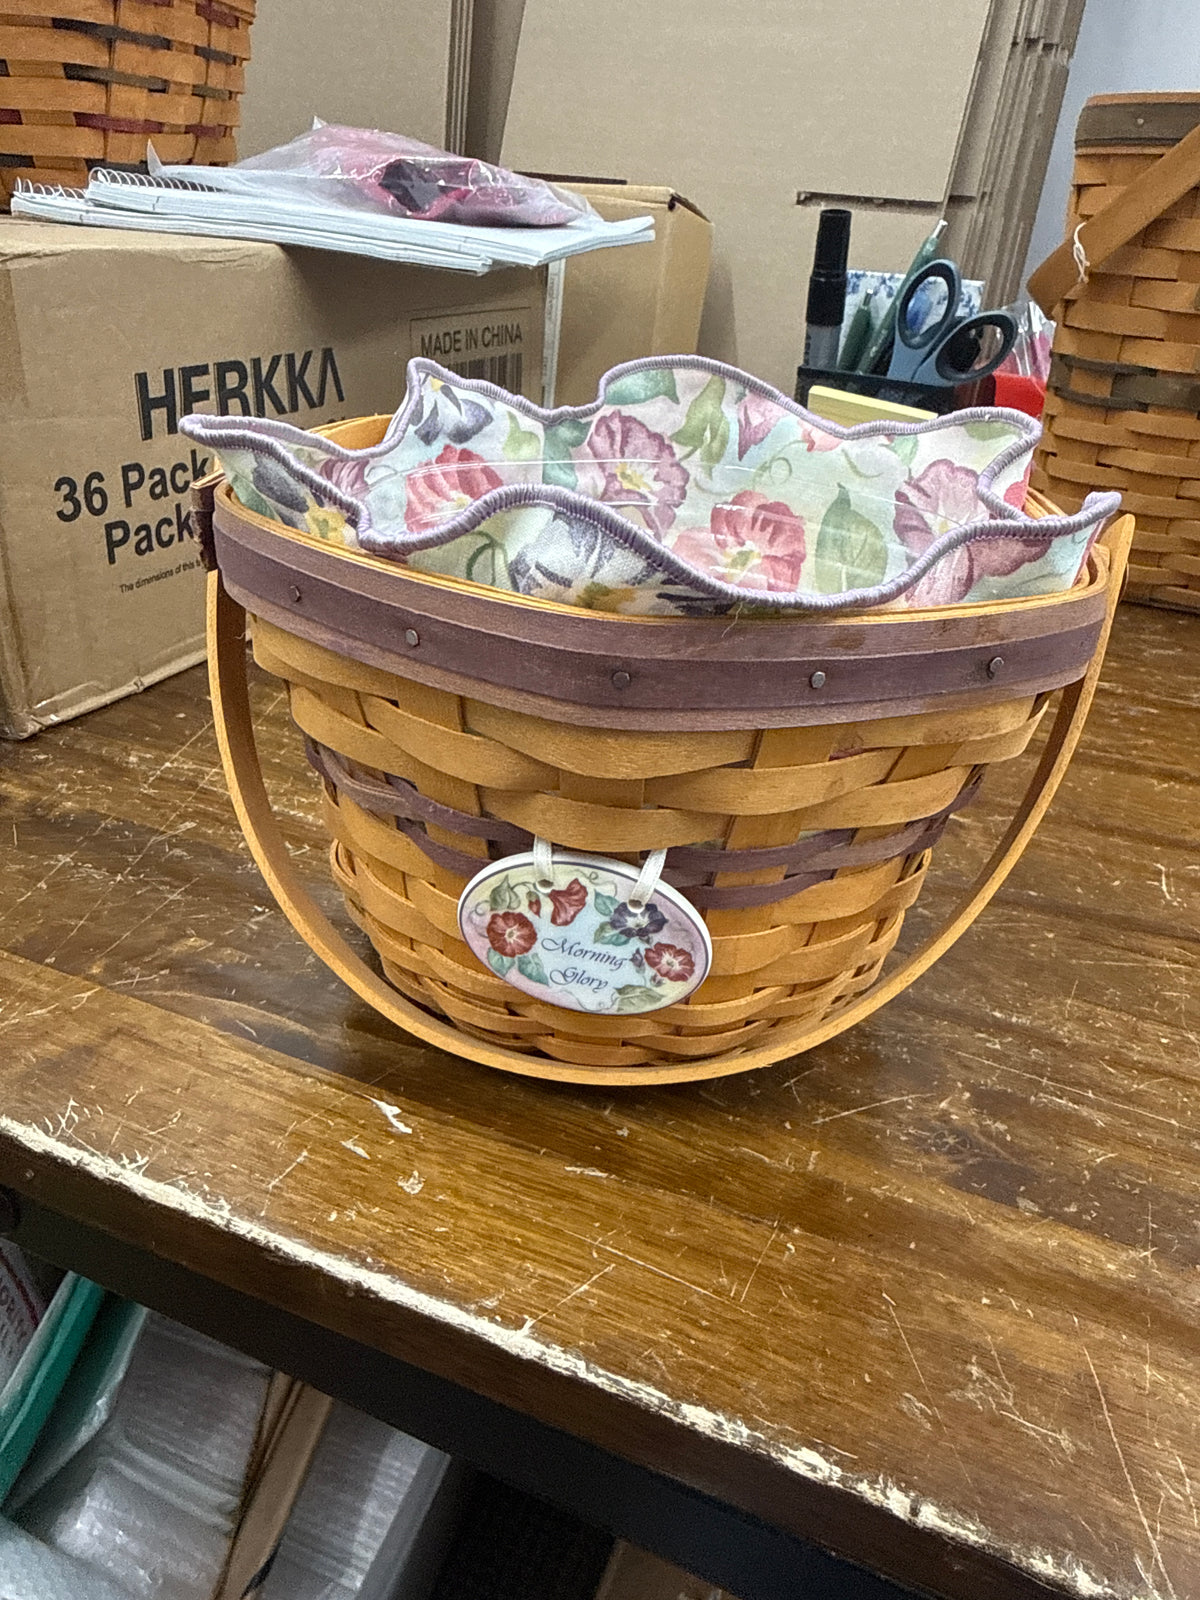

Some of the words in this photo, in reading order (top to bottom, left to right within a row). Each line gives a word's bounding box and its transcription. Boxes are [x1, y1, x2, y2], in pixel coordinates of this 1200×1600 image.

[420, 331, 461, 357] MADE
[465, 328, 478, 351] IN
[481, 323, 523, 349] CHINA
[54, 471, 109, 523] 36
[120, 583, 134, 594] The
[135, 569, 173, 588] dimensions
[175, 563, 181, 574] of
[182, 560, 195, 572] this
[541, 937, 627, 972] Morning
[549, 966, 609, 993] Glory
